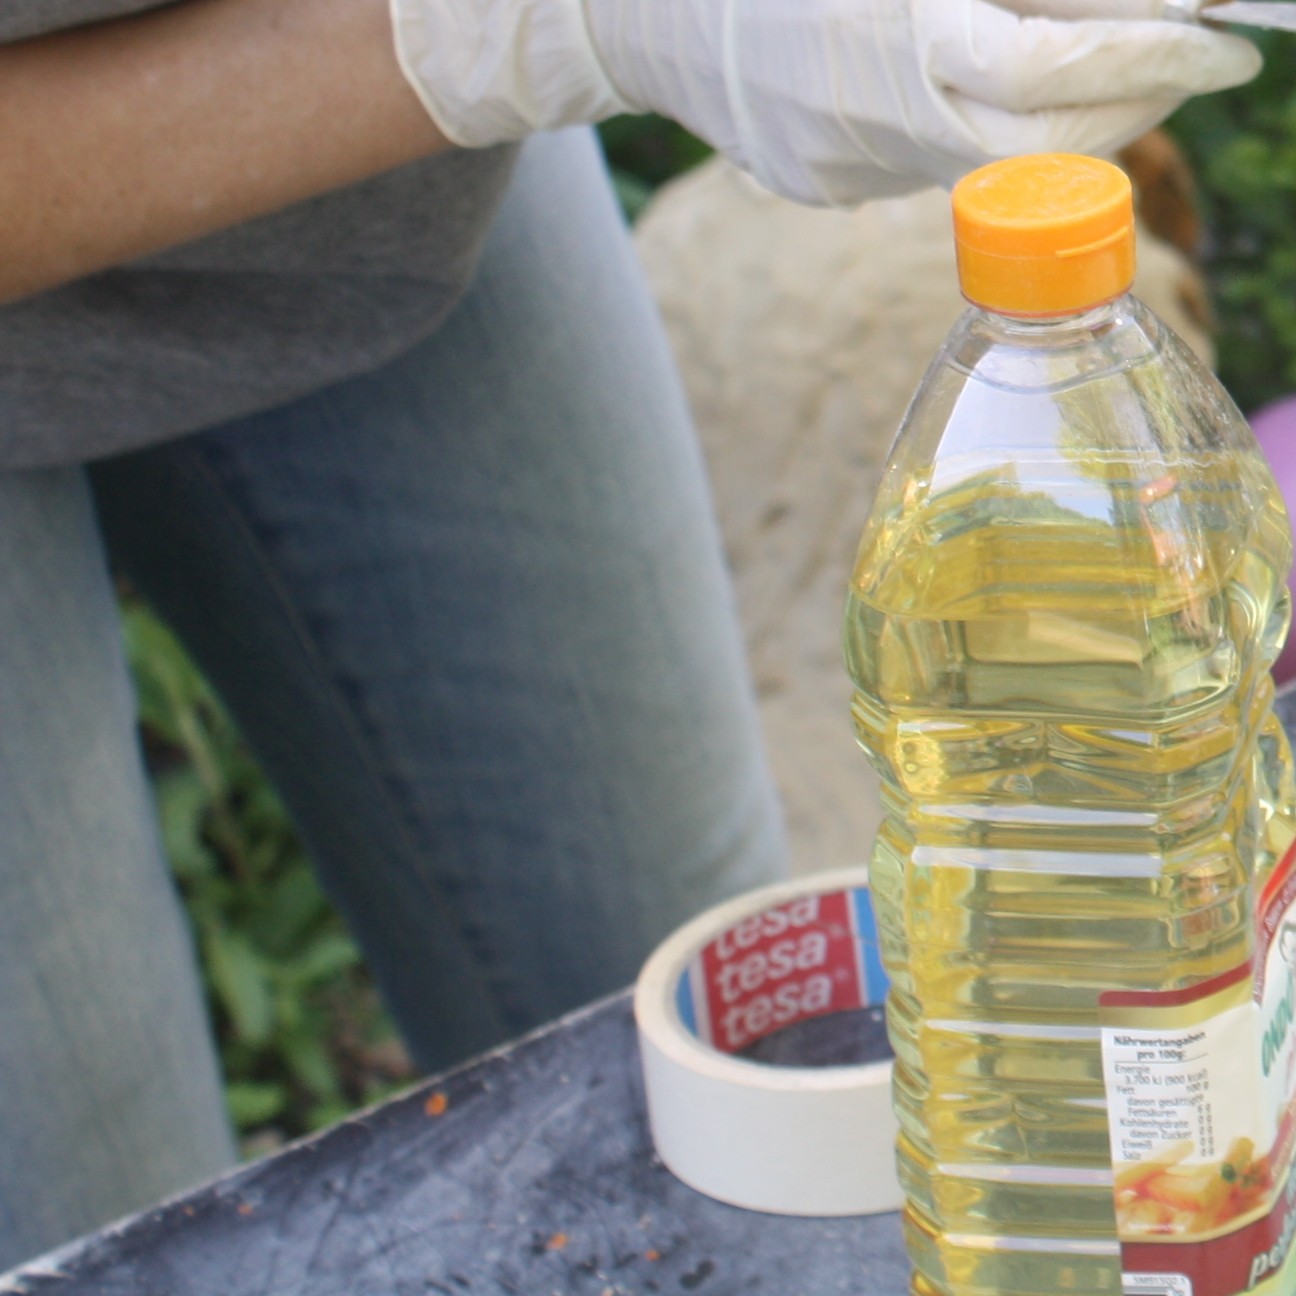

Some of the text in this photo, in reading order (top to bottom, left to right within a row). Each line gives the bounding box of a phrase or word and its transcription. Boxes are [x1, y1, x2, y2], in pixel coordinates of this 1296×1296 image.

[715, 895, 821, 961] tesa
[716, 932, 828, 1003] tesa
[722, 974, 833, 1046] tesa
[1113, 1032, 1206, 1048] Nährwertangaben
[1137, 1051, 1155, 1061] pro
[1114, 1064, 1150, 1076] Energie
[1116, 1085, 1135, 1095] Fett
[1127, 1097, 1156, 1106] davon
[1119, 1117, 1189, 1131] Kohlenhydrate
[1129, 1128, 1158, 1138] davon
